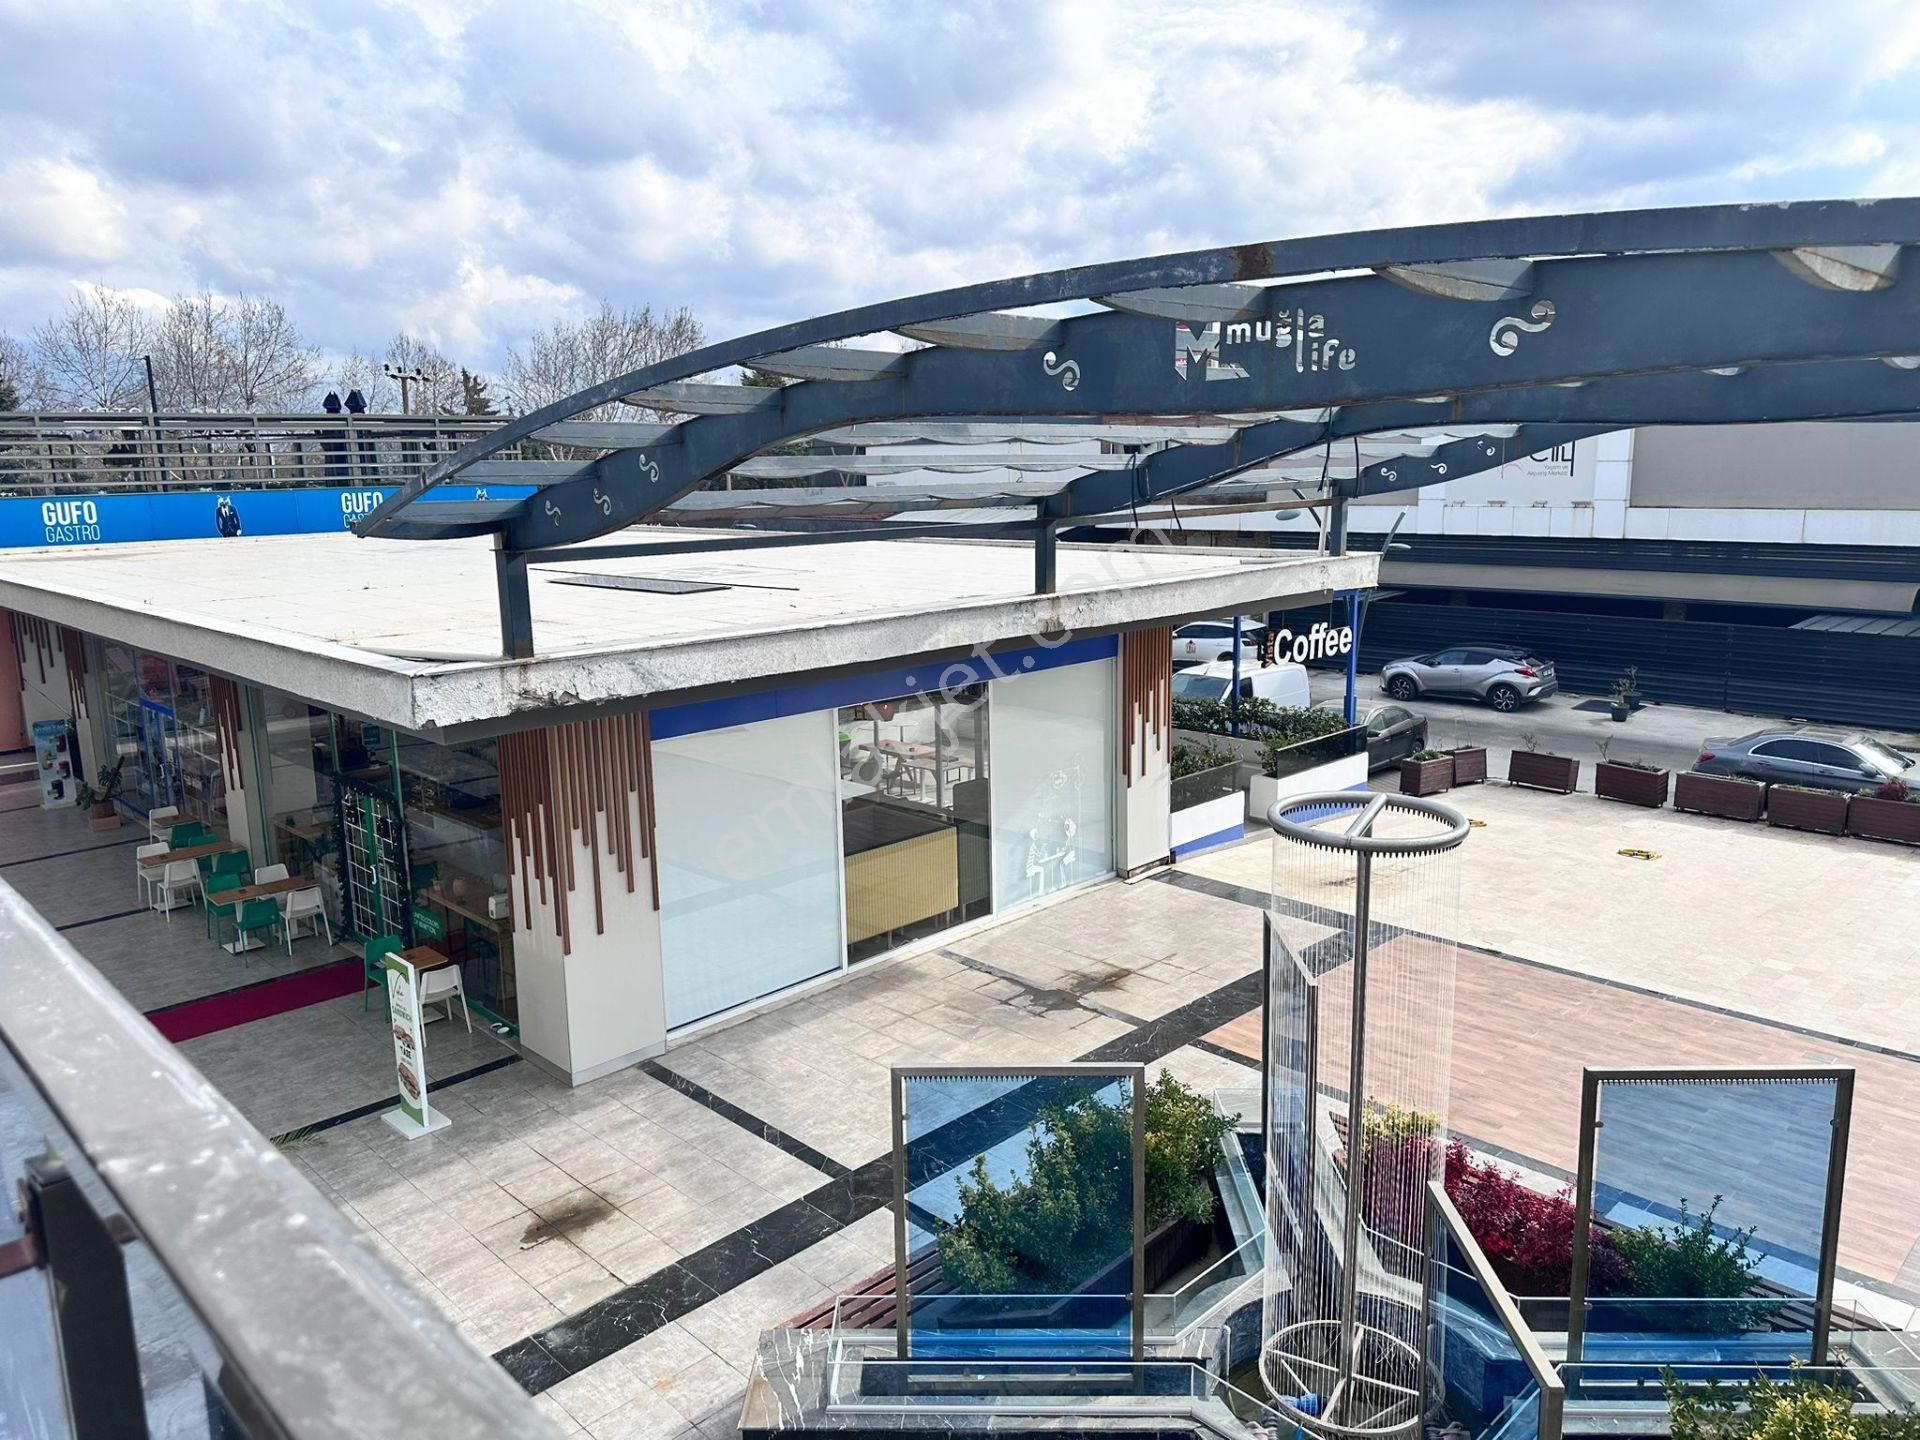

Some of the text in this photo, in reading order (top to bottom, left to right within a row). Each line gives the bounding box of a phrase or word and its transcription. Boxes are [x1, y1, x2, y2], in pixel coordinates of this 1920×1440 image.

[41, 501, 97, 526] GUFO
[45, 525, 101, 543] GASTRO
[1274, 622, 1353, 665] Coffee
